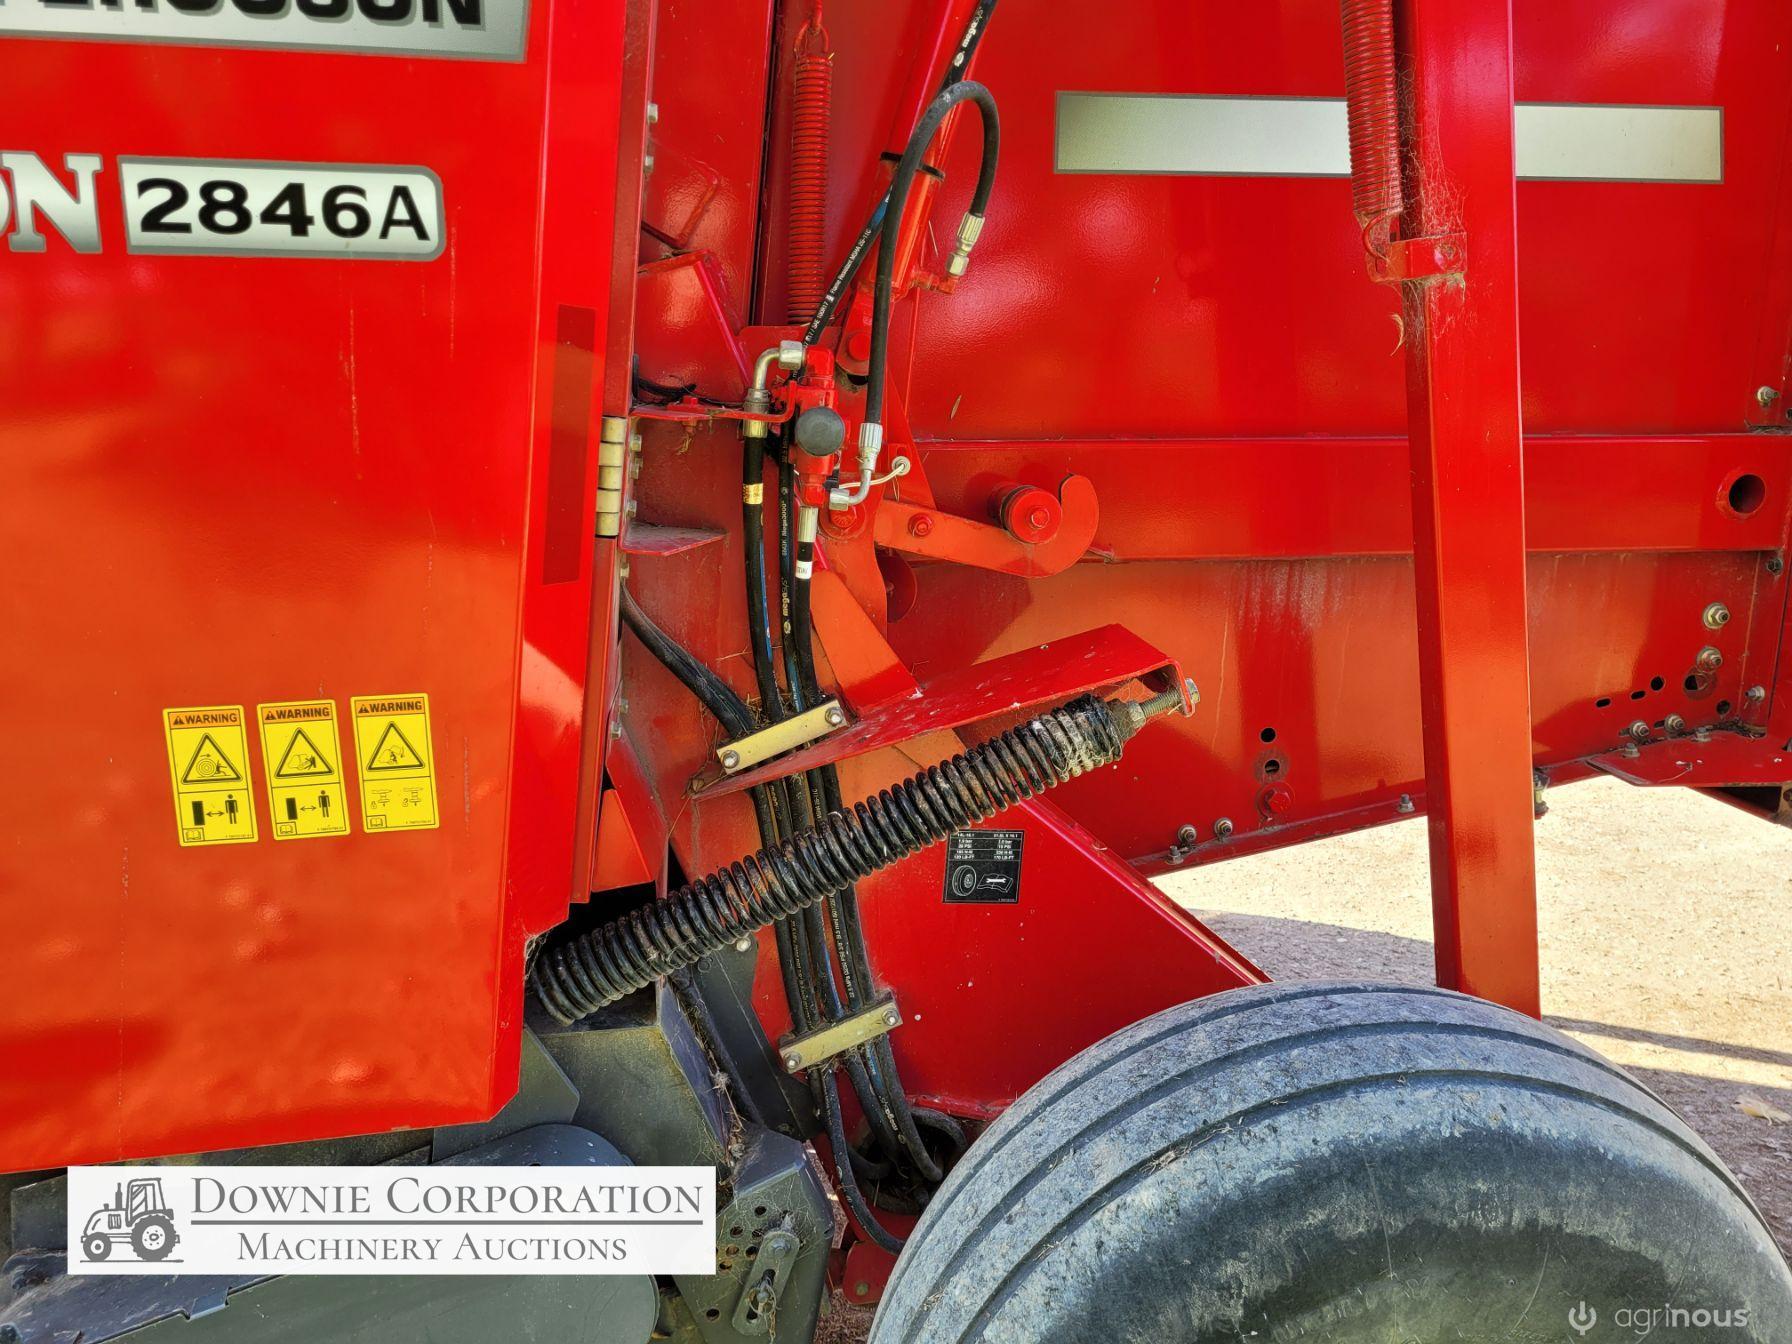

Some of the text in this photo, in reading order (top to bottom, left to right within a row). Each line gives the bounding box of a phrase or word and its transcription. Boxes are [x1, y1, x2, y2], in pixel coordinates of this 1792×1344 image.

[0, 151, 102, 253] N
[137, 177, 431, 242] 2846A
[276, 707, 330, 719] WARNING
[369, 700, 422, 713] WARNING
[185, 712, 238, 725] WARNING
